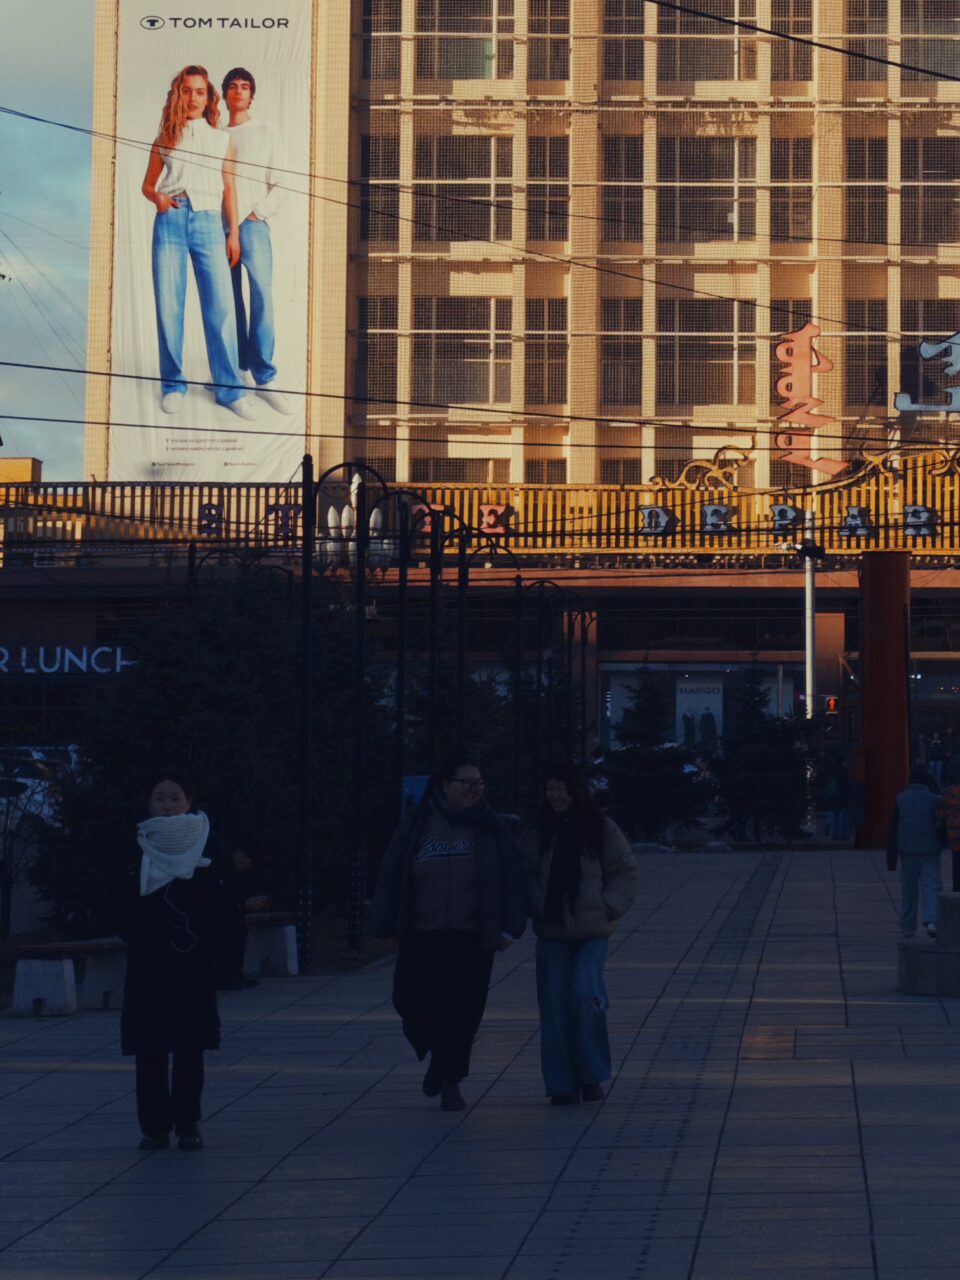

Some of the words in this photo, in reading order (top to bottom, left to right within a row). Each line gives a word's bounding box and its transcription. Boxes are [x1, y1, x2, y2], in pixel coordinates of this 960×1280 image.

[169, 17, 212, 28] TOM
[216, 17, 289, 29] TAILOR
[680, 687, 721, 695] MANGO
